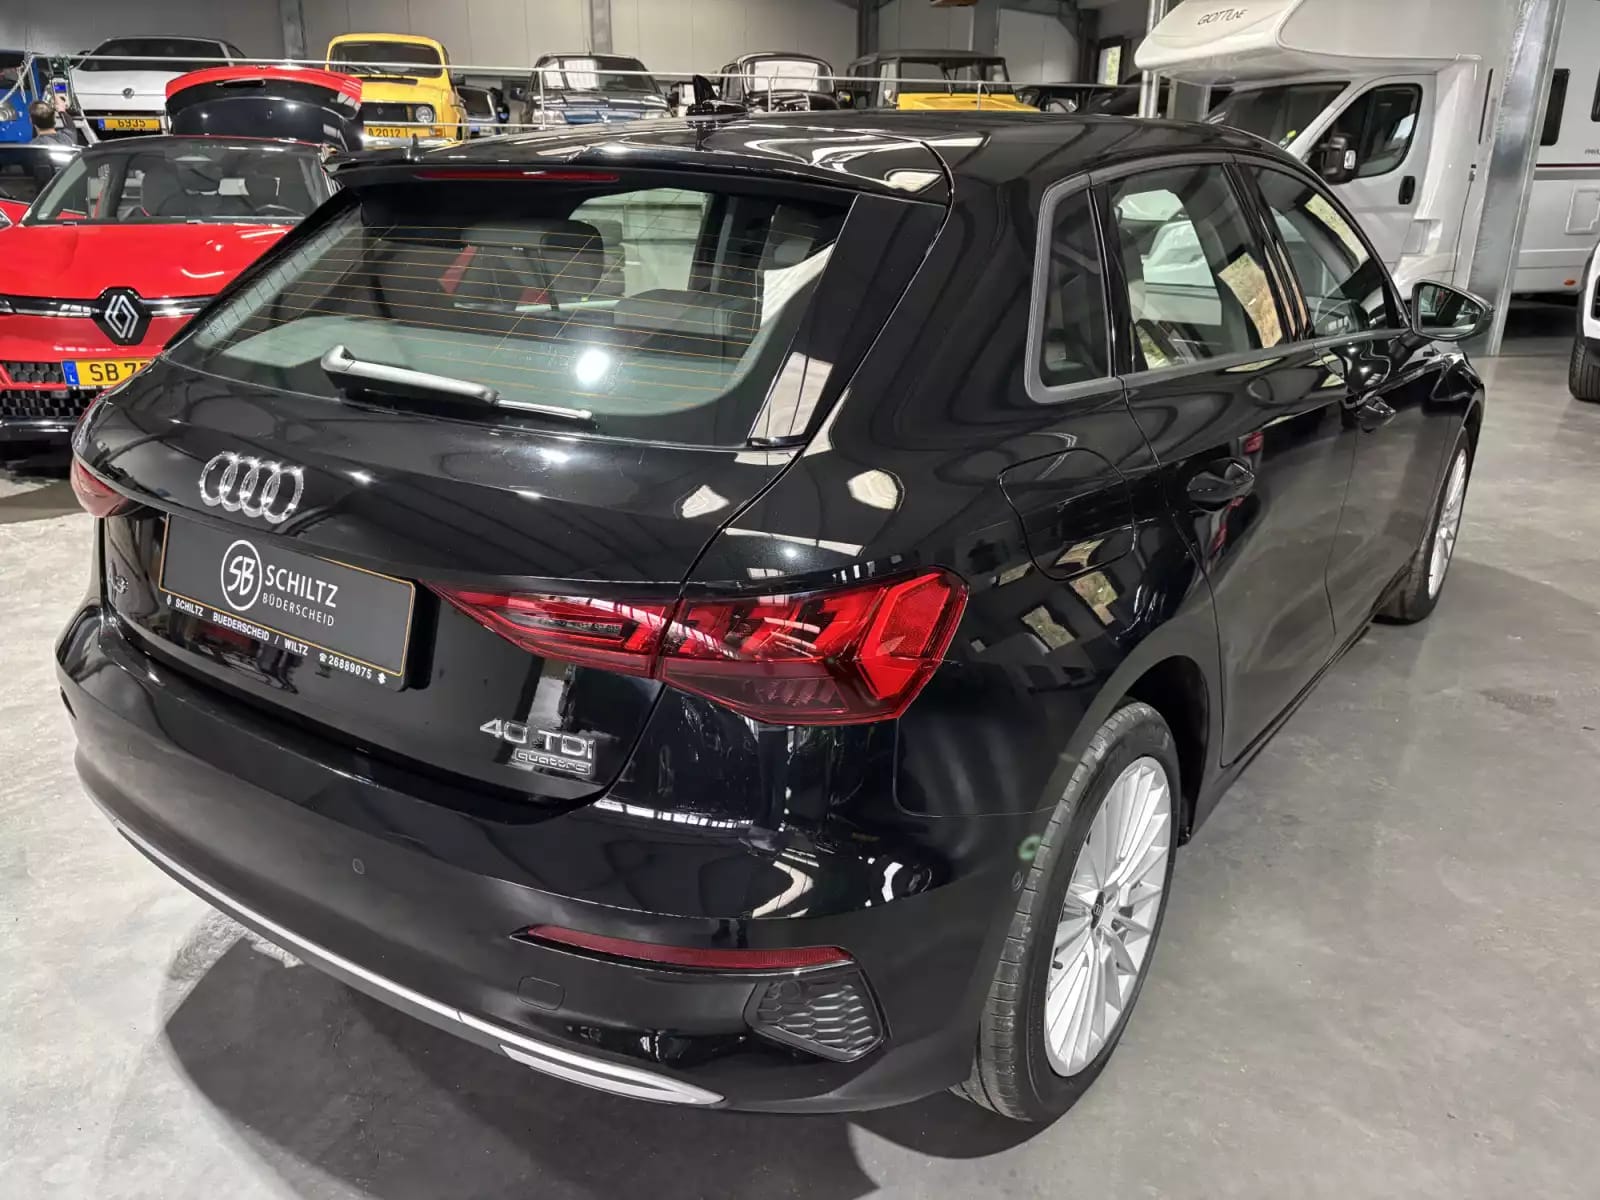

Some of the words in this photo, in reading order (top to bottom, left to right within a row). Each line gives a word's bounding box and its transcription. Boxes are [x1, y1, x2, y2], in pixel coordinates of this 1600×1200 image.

[89, 362, 120, 382] SB
[227, 555, 256, 596] SB
[264, 564, 339, 608] SCHILTZ
[175, 598, 204, 616] SCHILTZ
[212, 612, 270, 641] BUEDERSCHEID
[284, 638, 309, 656] WILTZ
[262, 592, 334, 626] BÜDERSCHEID
[480, 718, 528, 744] 40
[537, 729, 595, 760] TDI
[517, 751, 589, 773] quattro
